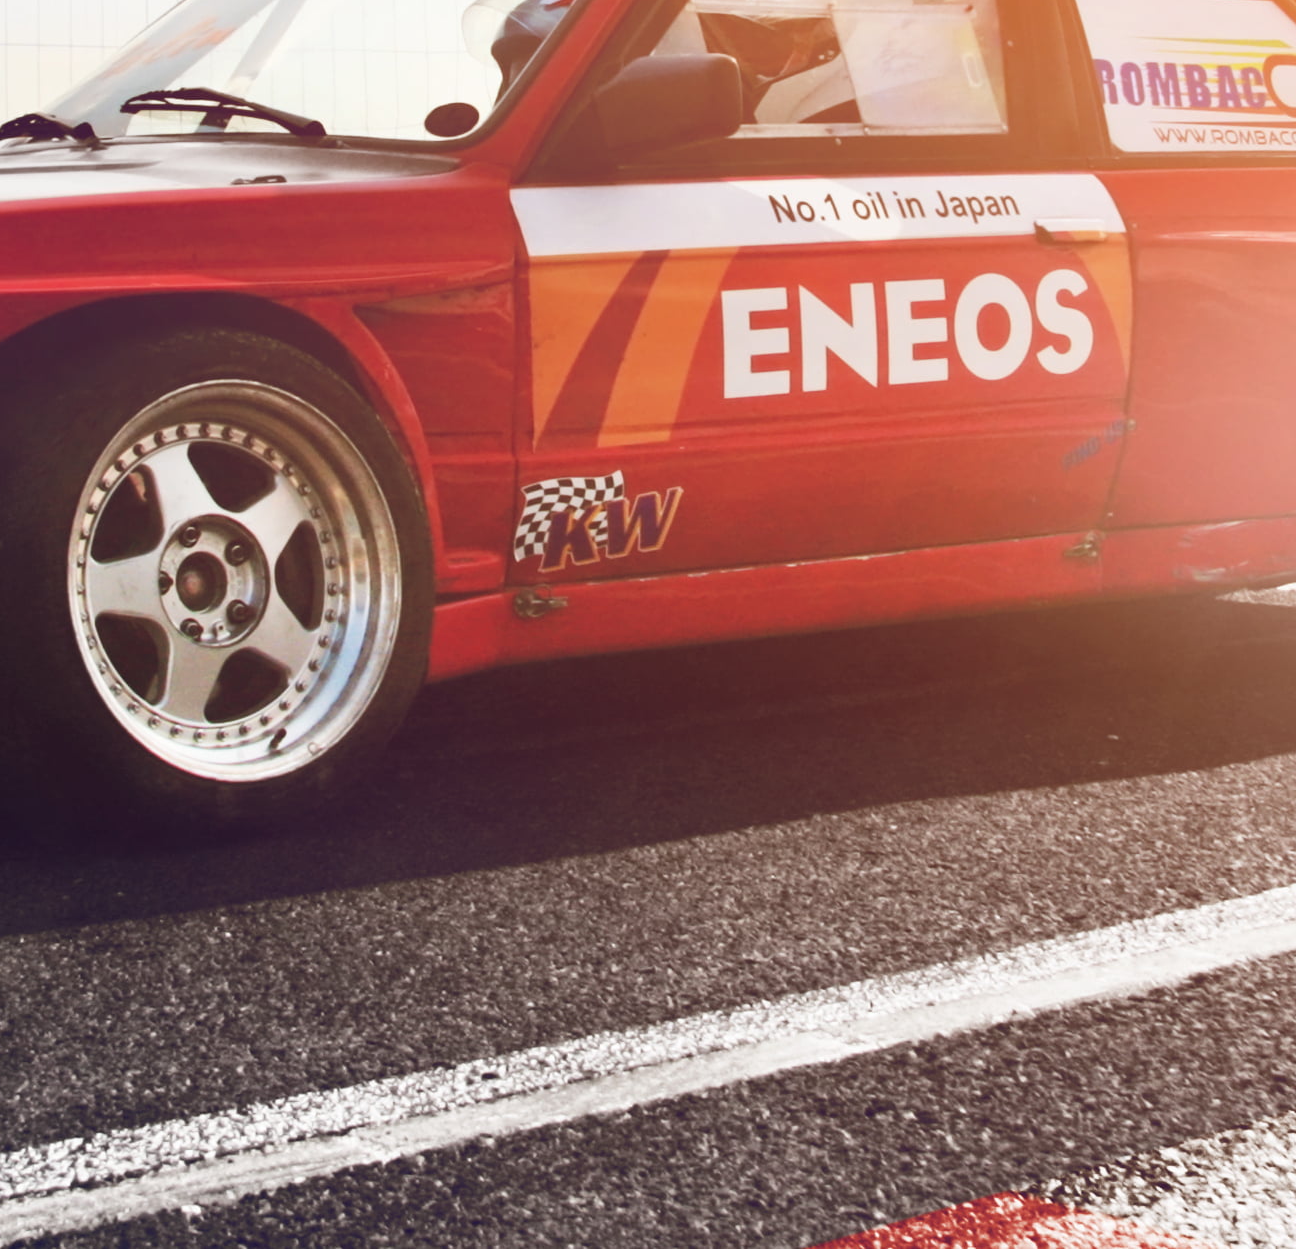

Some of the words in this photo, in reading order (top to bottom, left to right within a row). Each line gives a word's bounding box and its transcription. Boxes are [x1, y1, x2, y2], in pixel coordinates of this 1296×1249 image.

[768, 193, 841, 223] No.1
[852, 191, 889, 220] oil
[892, 191, 926, 219] in
[935, 190, 1021, 224] Japan
[721, 269, 1094, 399] ENEOS
[538, 486, 684, 573] KW
